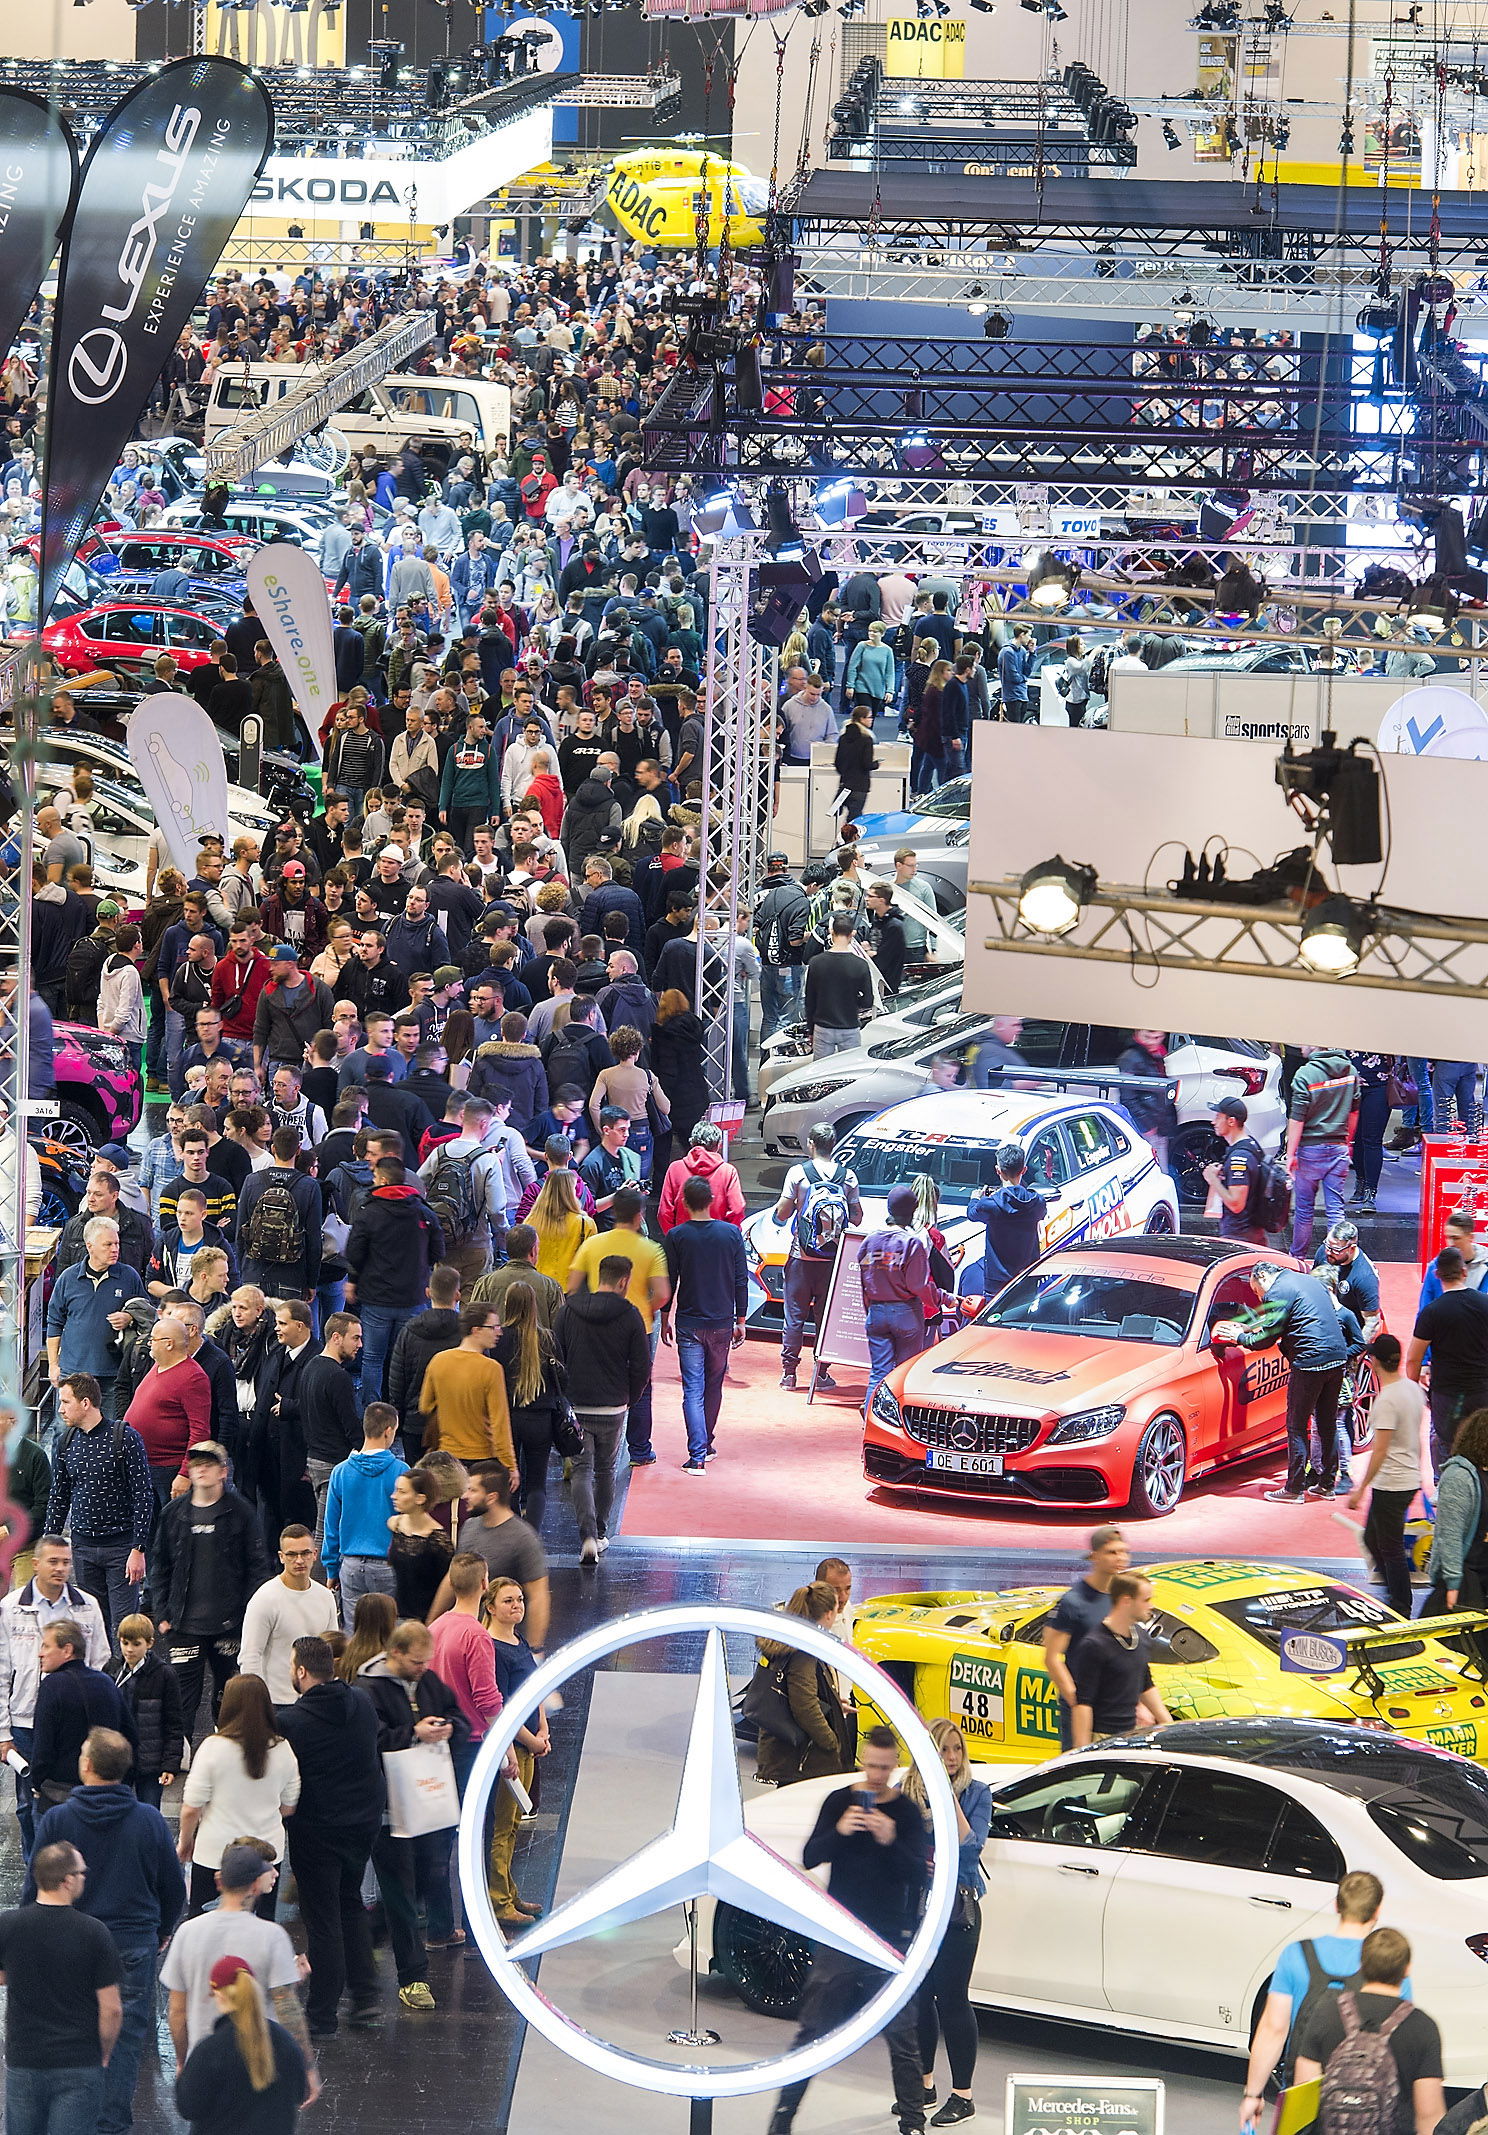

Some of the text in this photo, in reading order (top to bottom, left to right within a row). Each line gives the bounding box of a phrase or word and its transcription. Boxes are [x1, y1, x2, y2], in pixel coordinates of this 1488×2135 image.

[890, 21, 943, 42] ADAC
[945, 23, 966, 42] ADAC
[101, 103, 202, 323] LEXUS
[609, 170, 667, 238] ADAC
[143, 118, 232, 335] EXPERIENCE AMAZING
[1061, 519, 1098, 533] TOYO
[263, 575, 321, 696] eShare.one
[35, 1107, 54, 1115] 3A16
[896, 1129, 949, 1143] TCR
[861, 1138, 937, 1157] Engstler
[1088, 1181, 1123, 1219] LIQUI
[1089, 1204, 1131, 1241] MOLY
[1063, 1265, 1166, 1284] eibach.de
[932, 1361, 1072, 1382] Eibach
[937, 1454, 953, 1468] OE
[1336, 1600, 1384, 1623] 48
[951, 1660, 1003, 1690] DEKRA
[1020, 1674, 1060, 1706] MA
[962, 1691, 990, 1718] 48
[960, 1715, 994, 1737] ADAC
[1020, 1703, 1061, 1734] FIL
[1428, 1726, 1476, 1745] MANN
[1065, 2116, 1100, 2126] SHOP
